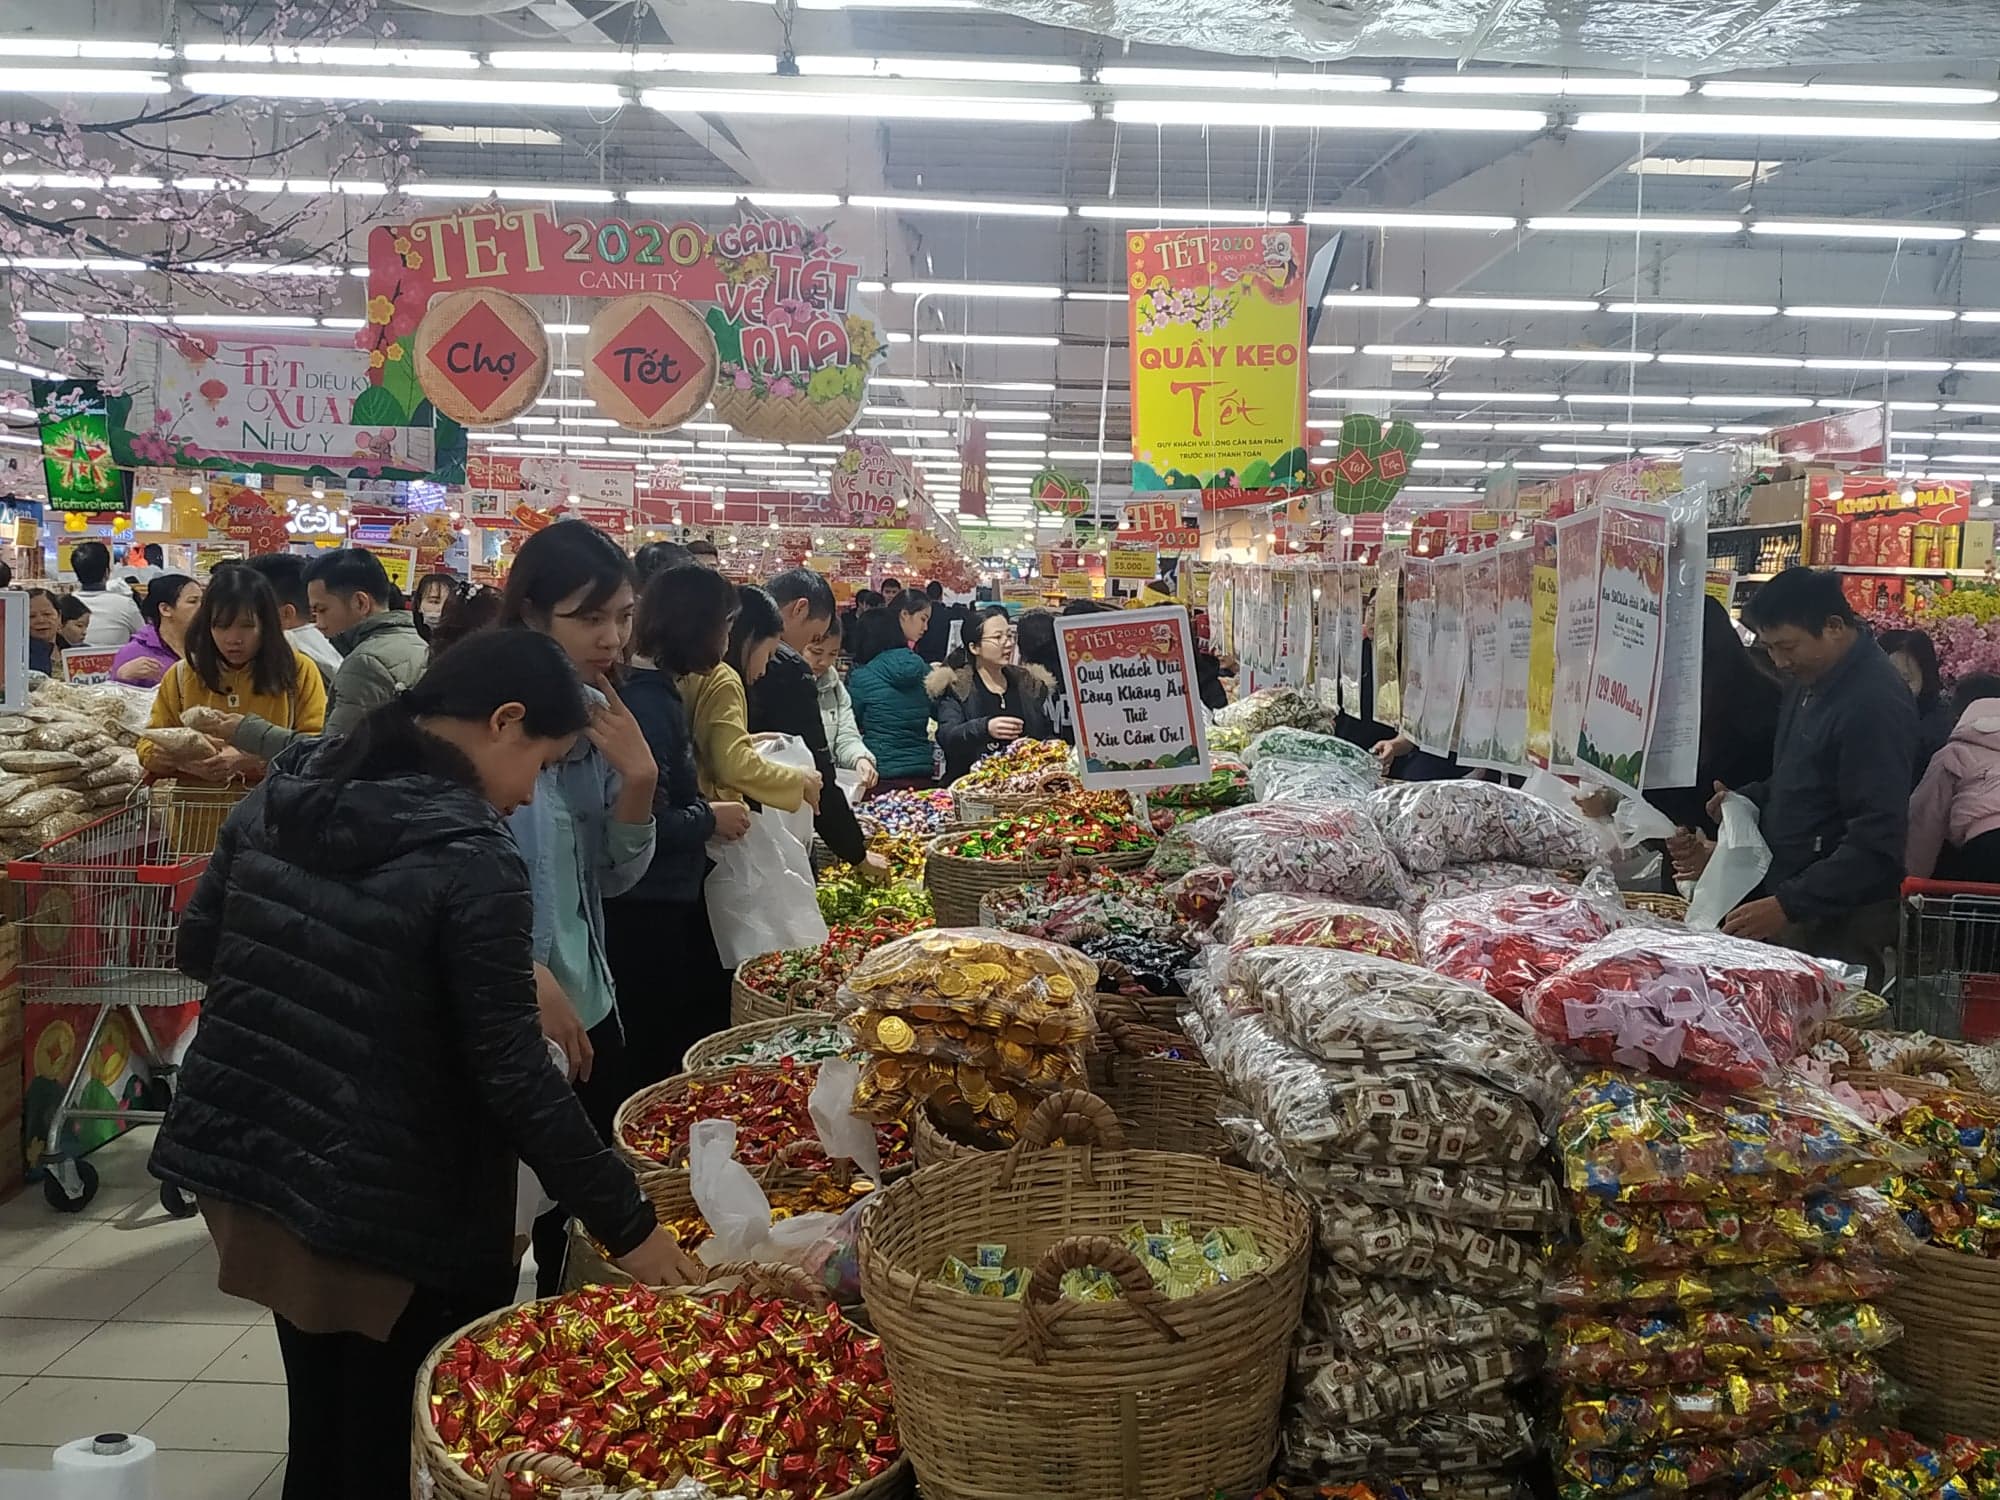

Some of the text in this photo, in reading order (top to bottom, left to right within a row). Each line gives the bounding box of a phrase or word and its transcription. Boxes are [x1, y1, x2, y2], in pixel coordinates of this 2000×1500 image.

[561, 222, 701, 265] 2020
[1153, 231, 1255, 271] TẾT 2020
[579, 270, 683, 292] CANH TÝ
[771, 246, 859, 312] TẾT
[447, 341, 517, 381] Chợ
[614, 346, 681, 384] Tết
[247, 387, 357, 429] XUÂ
[1170, 381, 1264, 437] Tết
[1154, 532, 1198, 545] 2020
[1110, 662, 1153, 681] Khách
[1117, 684, 1162, 702] Không
[1094, 732, 1121, 748] Xin
